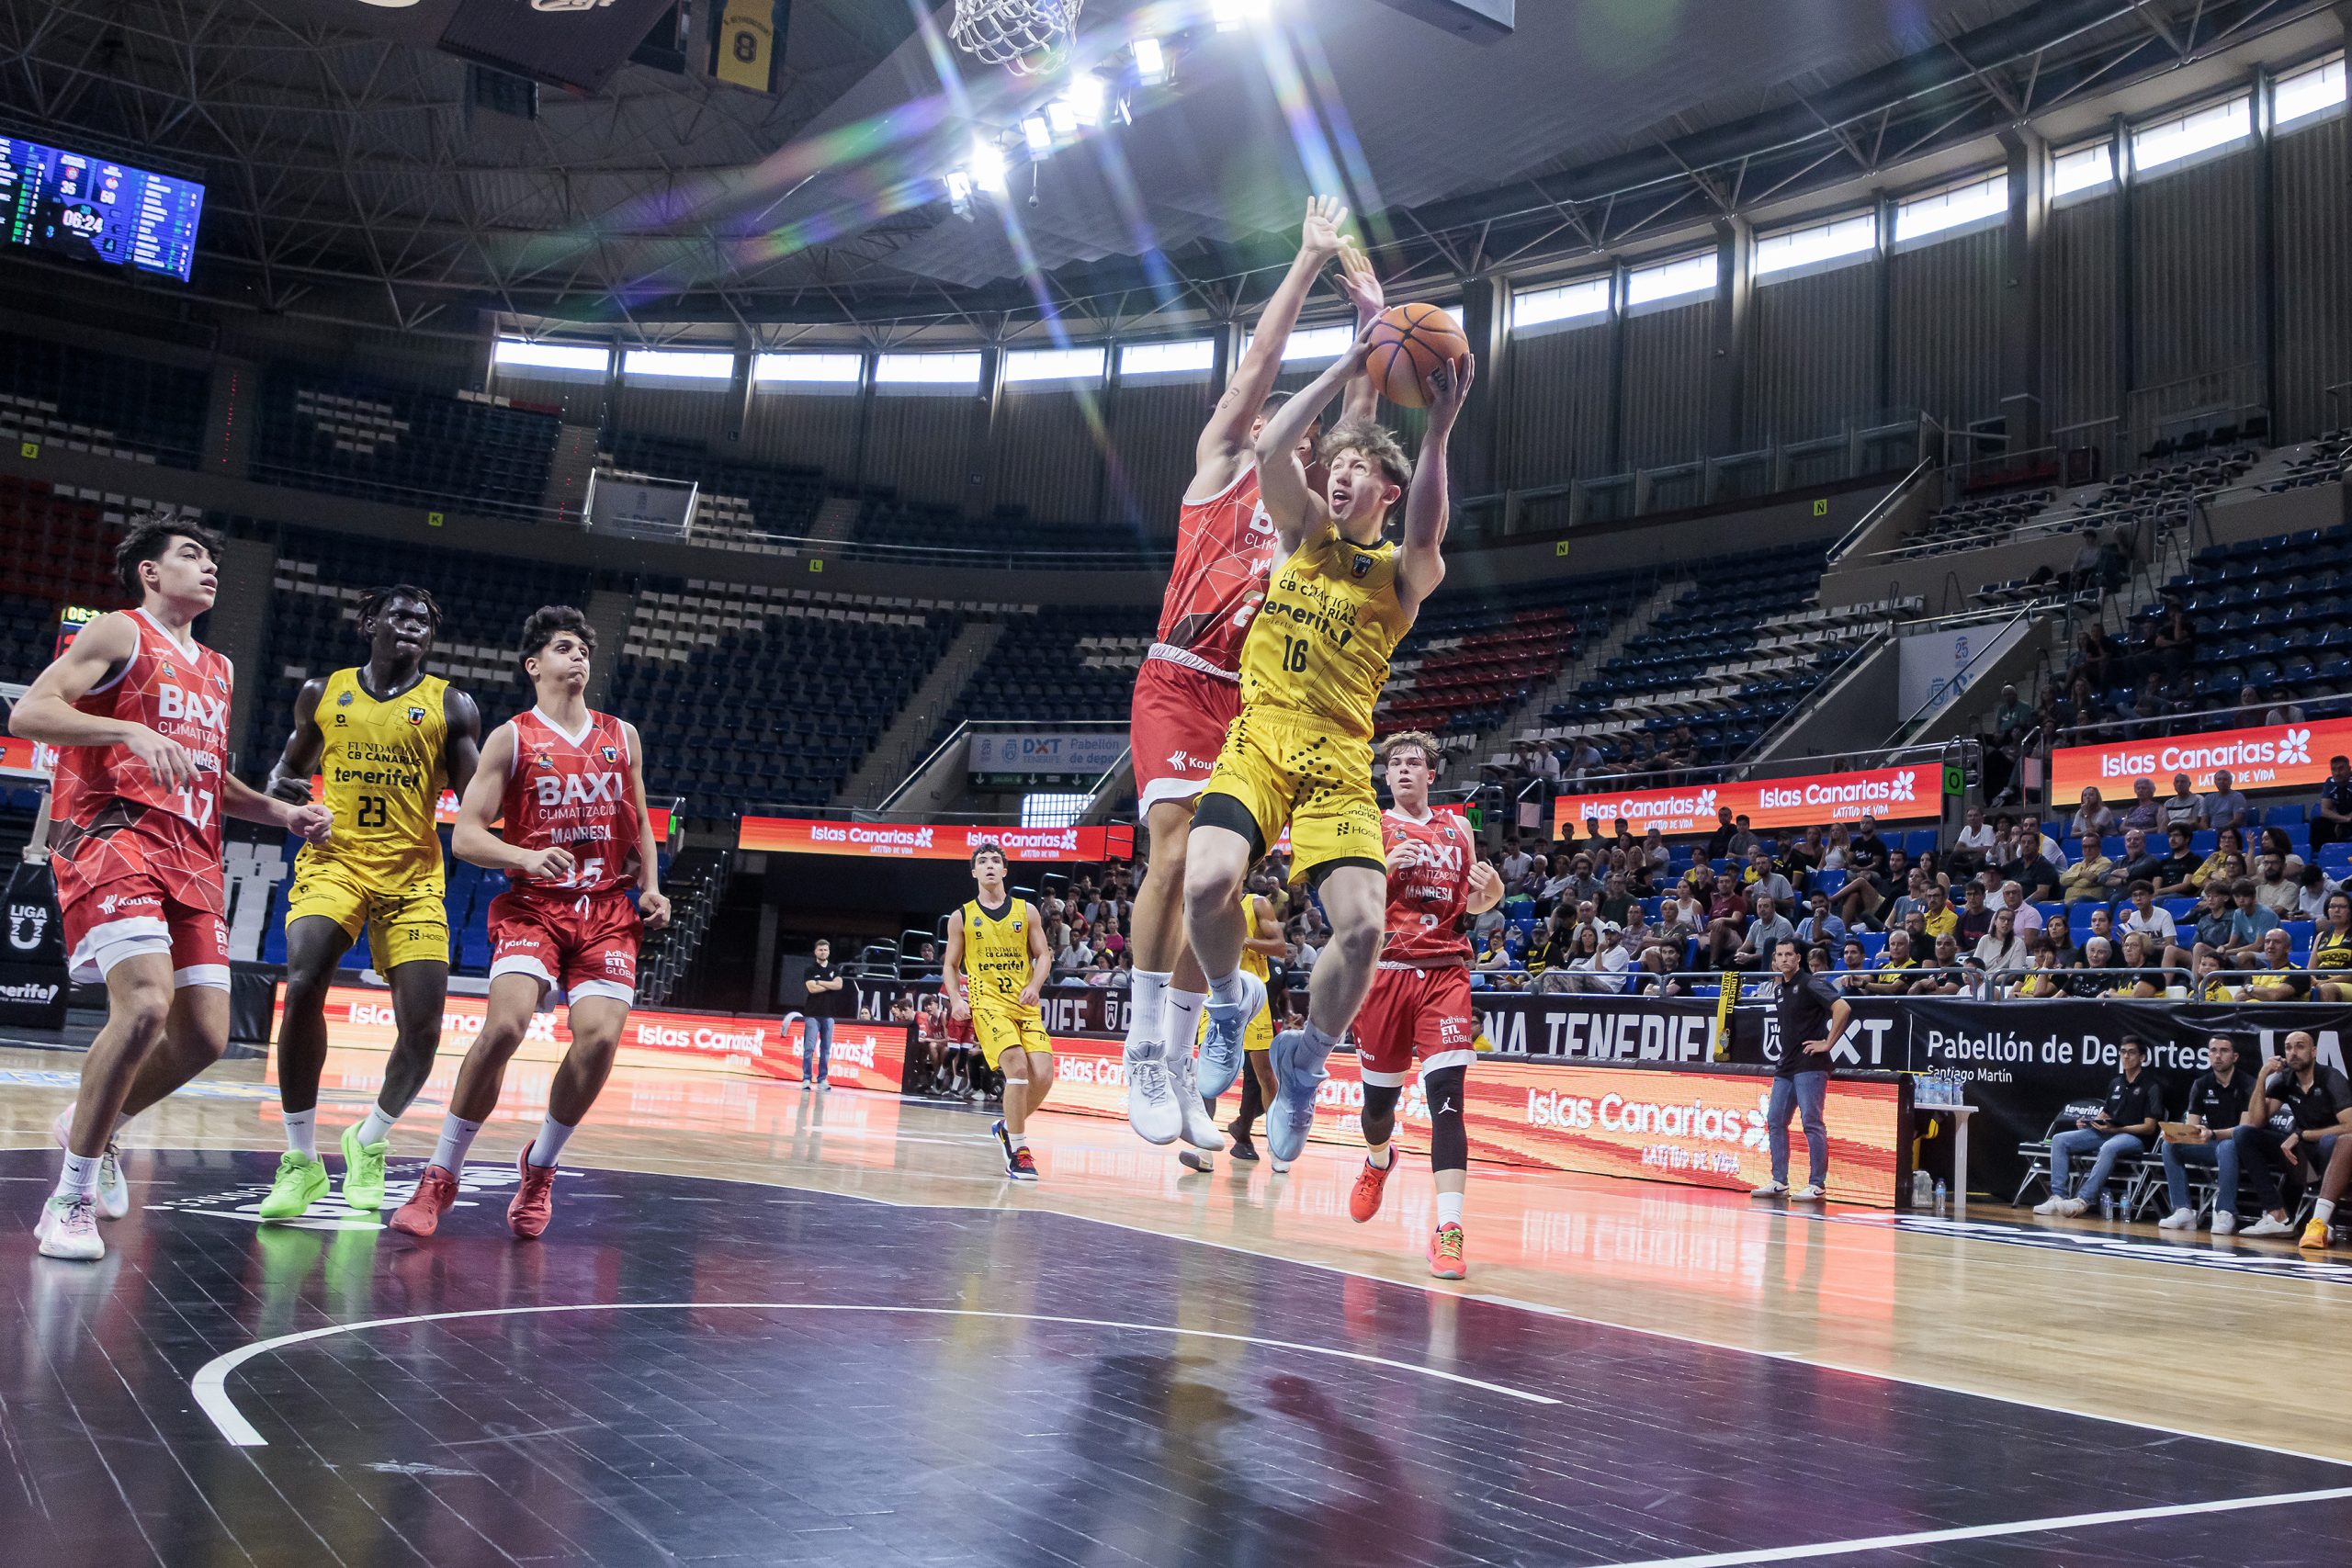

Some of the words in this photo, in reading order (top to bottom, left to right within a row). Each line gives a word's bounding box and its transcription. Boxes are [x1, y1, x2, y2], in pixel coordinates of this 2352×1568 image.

[734, 30, 757, 63] 8
[62, 209, 104, 232] 06:24
[1559, 544, 1566, 553] N
[1279, 579, 1296, 592] CB
[1282, 634, 1309, 673] 16
[1954, 642, 1969, 660] 25
[159, 682, 228, 735] BAX
[347, 751, 362, 760] CB
[1023, 738, 1062, 754] DXT
[1070, 738, 1119, 750] Pabellón
[1070, 753, 1082, 763] de
[2102, 753, 2155, 777] Islas
[2161, 739, 2275, 772] Canarias
[2239, 772, 2249, 783] DE
[2254, 768, 2275, 782] VIDA
[536, 773, 623, 806] BAXI
[1759, 787, 1801, 809] Islas
[1805, 779, 1890, 805] Canarias
[177, 785, 215, 829] 17
[358, 795, 387, 827] 23
[1580, 801, 1617, 820] Islas
[1621, 795, 1694, 818] Canarias
[1833, 806, 1860, 818] LATITUD
[1862, 806, 1871, 816] DE
[1872, 804, 1889, 816] VIDA
[1471, 811, 1479, 827] N
[551, 824, 611, 844] MANRESA
[811, 826, 846, 842] Islas
[850, 827, 914, 845] Canarias
[967, 831, 999, 847] Islas
[1001, 831, 1060, 849] Canarias
[1395, 843, 1463, 872] AXI
[1405, 885, 1453, 902] MANRESA
[10, 905, 48, 919] LIGA
[605, 957, 628, 969] ETL
[997, 977, 1013, 993] 22
[349, 1002, 395, 1026] Isla
[637, 1024, 689, 1047] Islas
[694, 1028, 754, 1050] Canarias
[1441, 1024, 1460, 1036] ETL
[1826, 1019, 1894, 1065] XT
[1928, 1030, 2035, 1063] Pabellón
[2041, 1034, 2074, 1064] de
[1059, 1056, 1094, 1083] Islas
[1978, 1066, 2013, 1084] Martín
[1528, 1088, 1592, 1129] Islas
[1599, 1093, 1742, 1142] Canarias
[2064, 1102, 2104, 1116] tenerife!
